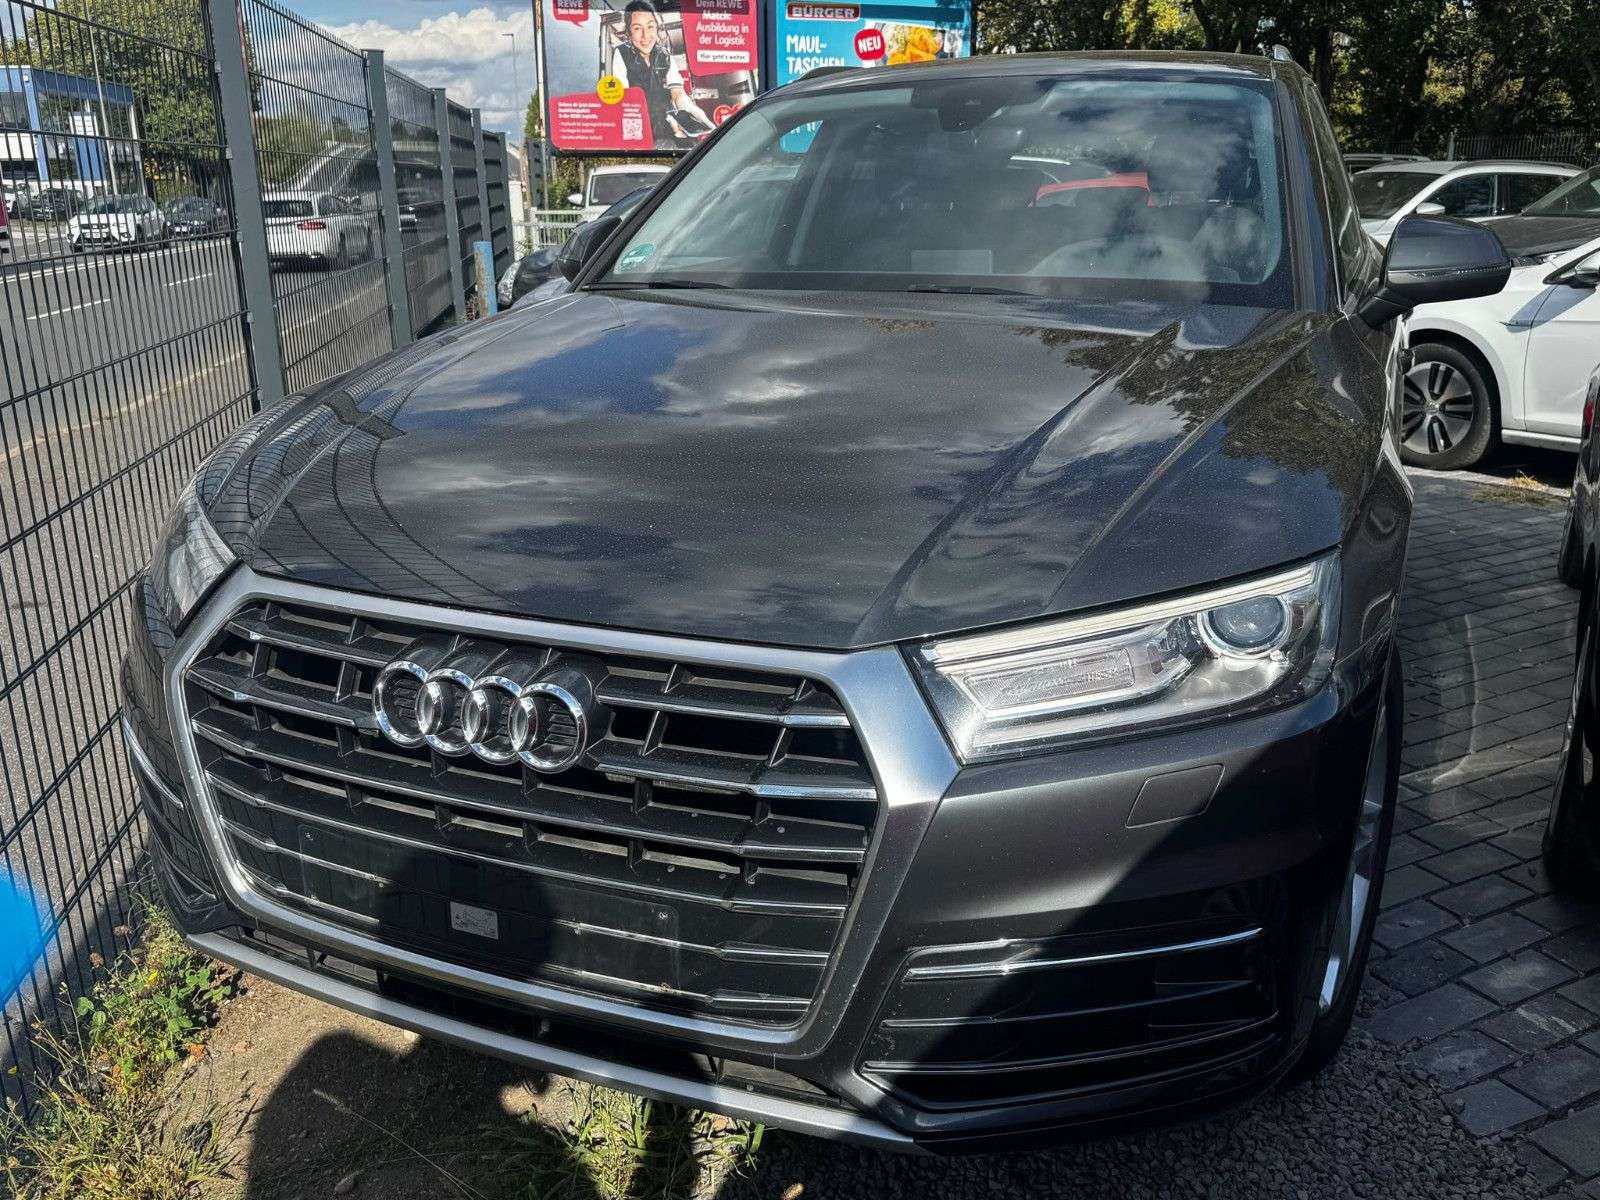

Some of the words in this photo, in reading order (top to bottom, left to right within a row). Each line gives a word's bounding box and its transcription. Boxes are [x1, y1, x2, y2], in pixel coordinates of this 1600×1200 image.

[557, 0, 583, 8] REWE
[696, 0, 715, 8] Dein
[716, 0, 744, 9] REWE
[792, 5, 855, 18] BÜRGER
[696, 22, 740, 35] Ausbildung
[741, 23, 750, 33] in
[699, 34, 713, 45] der
[715, 34, 745, 47] Logistik
[786, 34, 827, 53] MAUL-
[858, 36, 881, 53] NEU
